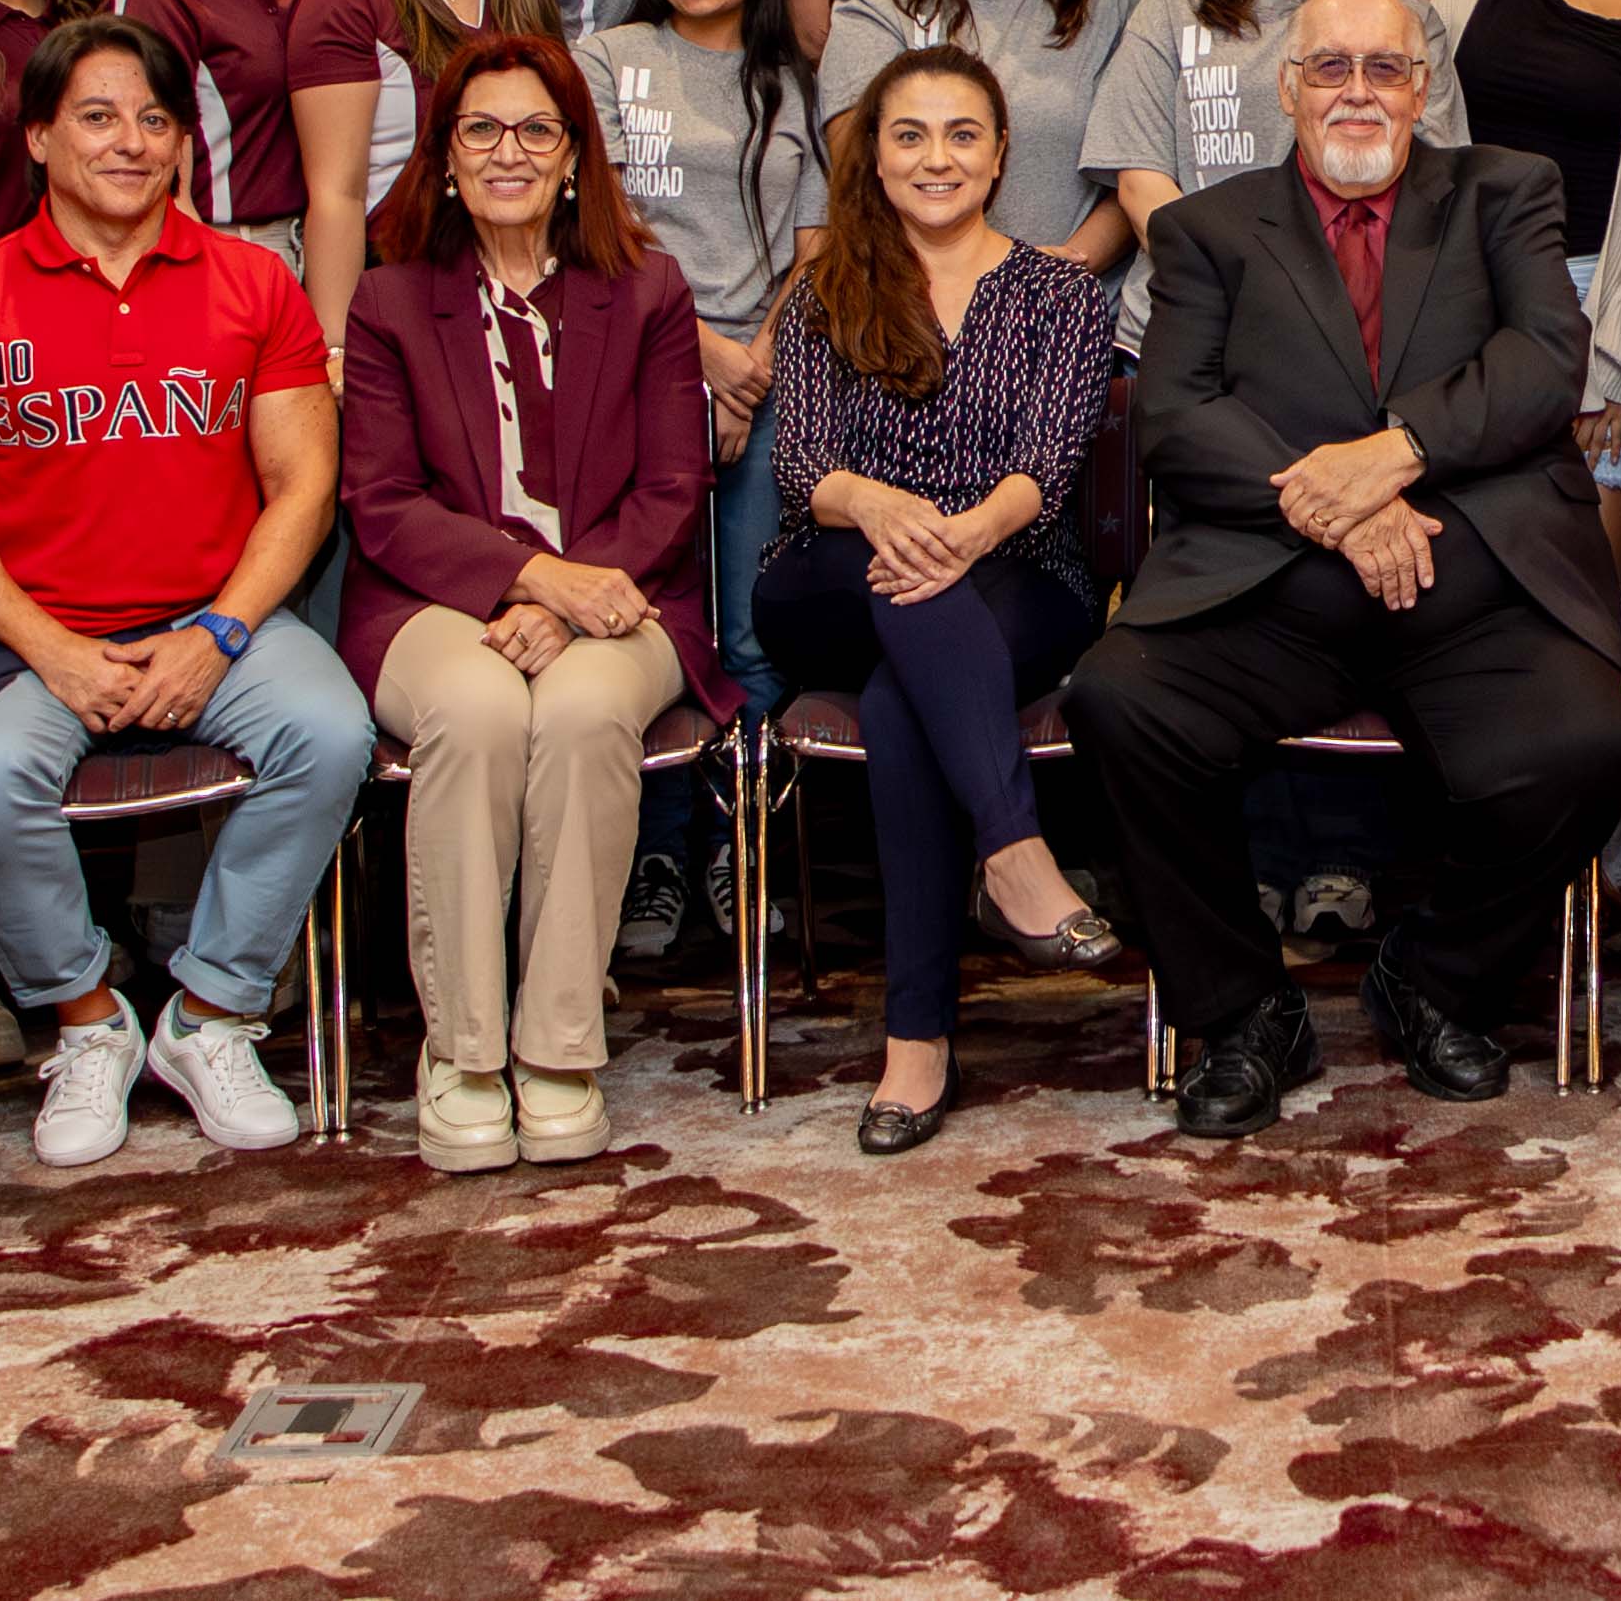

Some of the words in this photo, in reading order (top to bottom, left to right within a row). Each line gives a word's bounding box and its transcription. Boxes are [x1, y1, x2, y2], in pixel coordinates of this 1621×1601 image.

[1183, 65, 1237, 100] TAMIU
[619, 103, 672, 135] TAMIU
[1190, 97, 1241, 133] STUDY
[627, 134, 672, 166] TUDY
